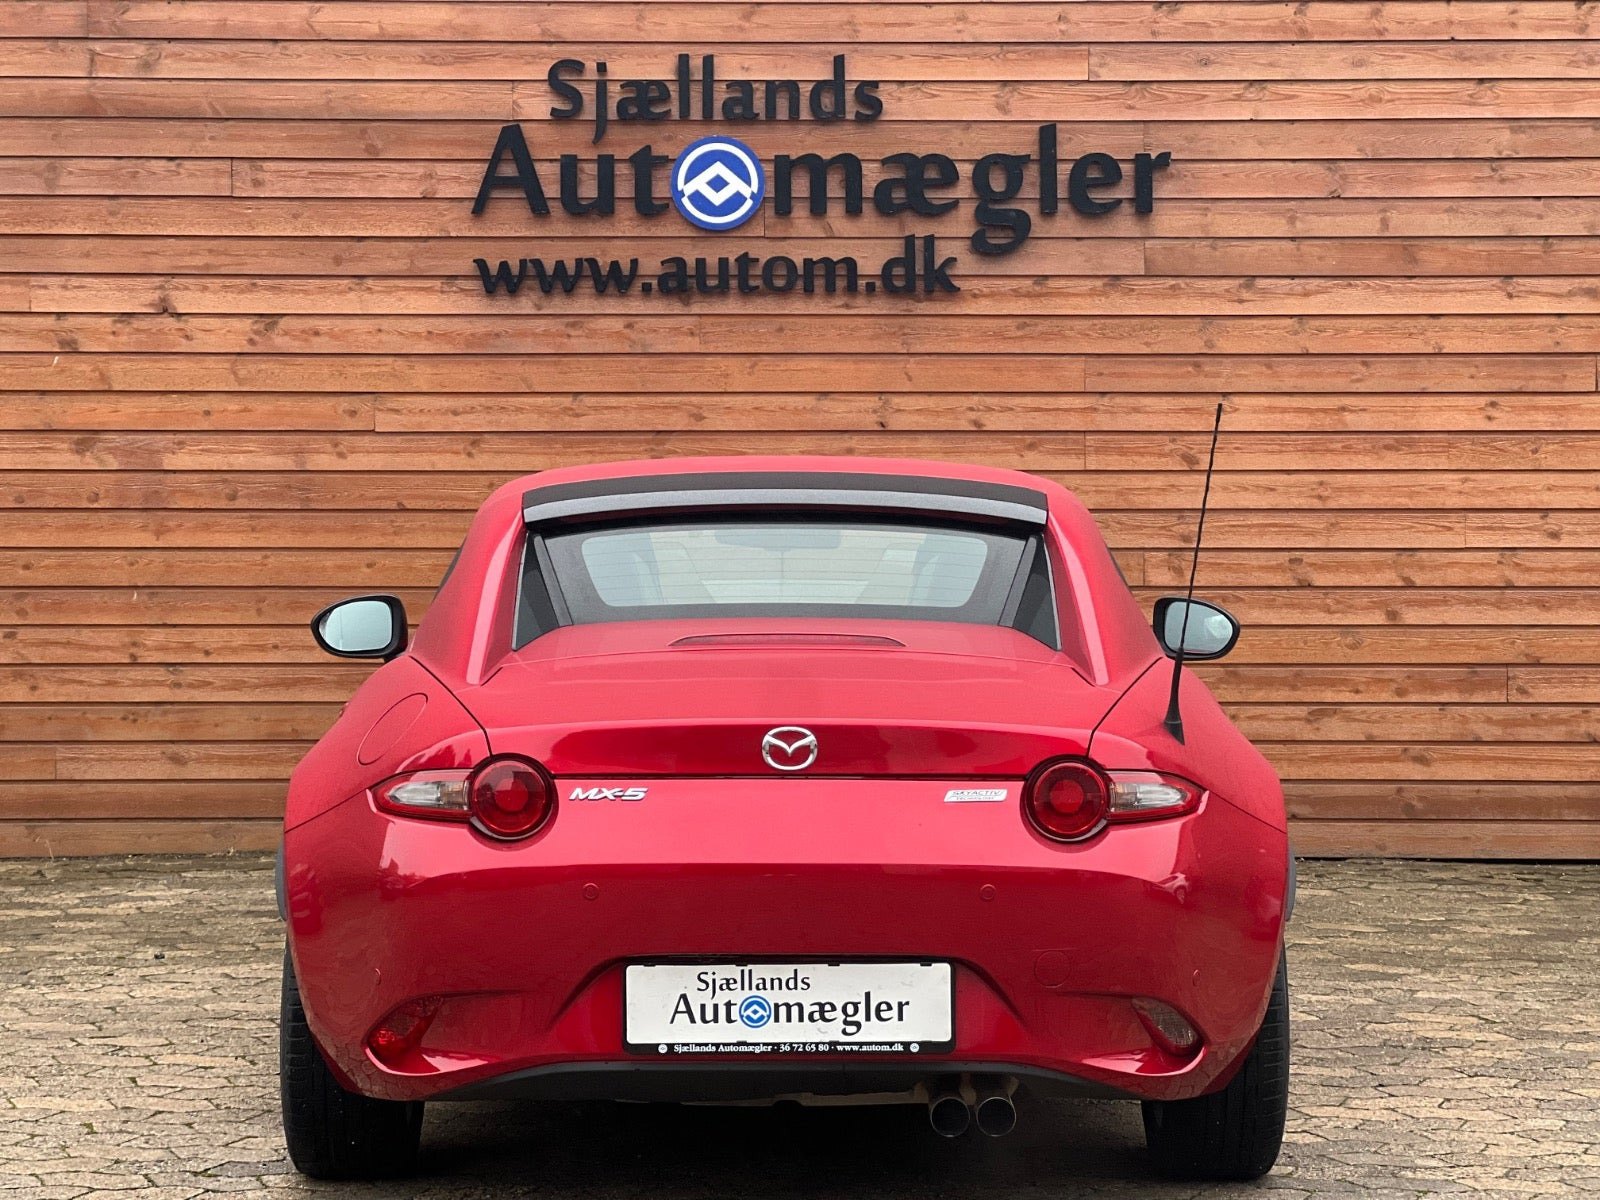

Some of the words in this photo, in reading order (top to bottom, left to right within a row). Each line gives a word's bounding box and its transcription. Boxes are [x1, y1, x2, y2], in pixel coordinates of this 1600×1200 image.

[547, 54, 884, 145] Sjællands
[472, 234, 961, 295] www.autom.dk
[569, 787, 648, 801] MX-5
[696, 968, 811, 999] Sjællands
[673, 1043, 717, 1054] Sjællands
[717, 1043, 773, 1054] Automægler
[780, 1043, 791, 1053] 36
[793, 1043, 804, 1052] 72
[805, 1043, 816, 1053] 65
[818, 1043, 829, 1052] 80
[836, 1042, 905, 1052] www.autom.dk
